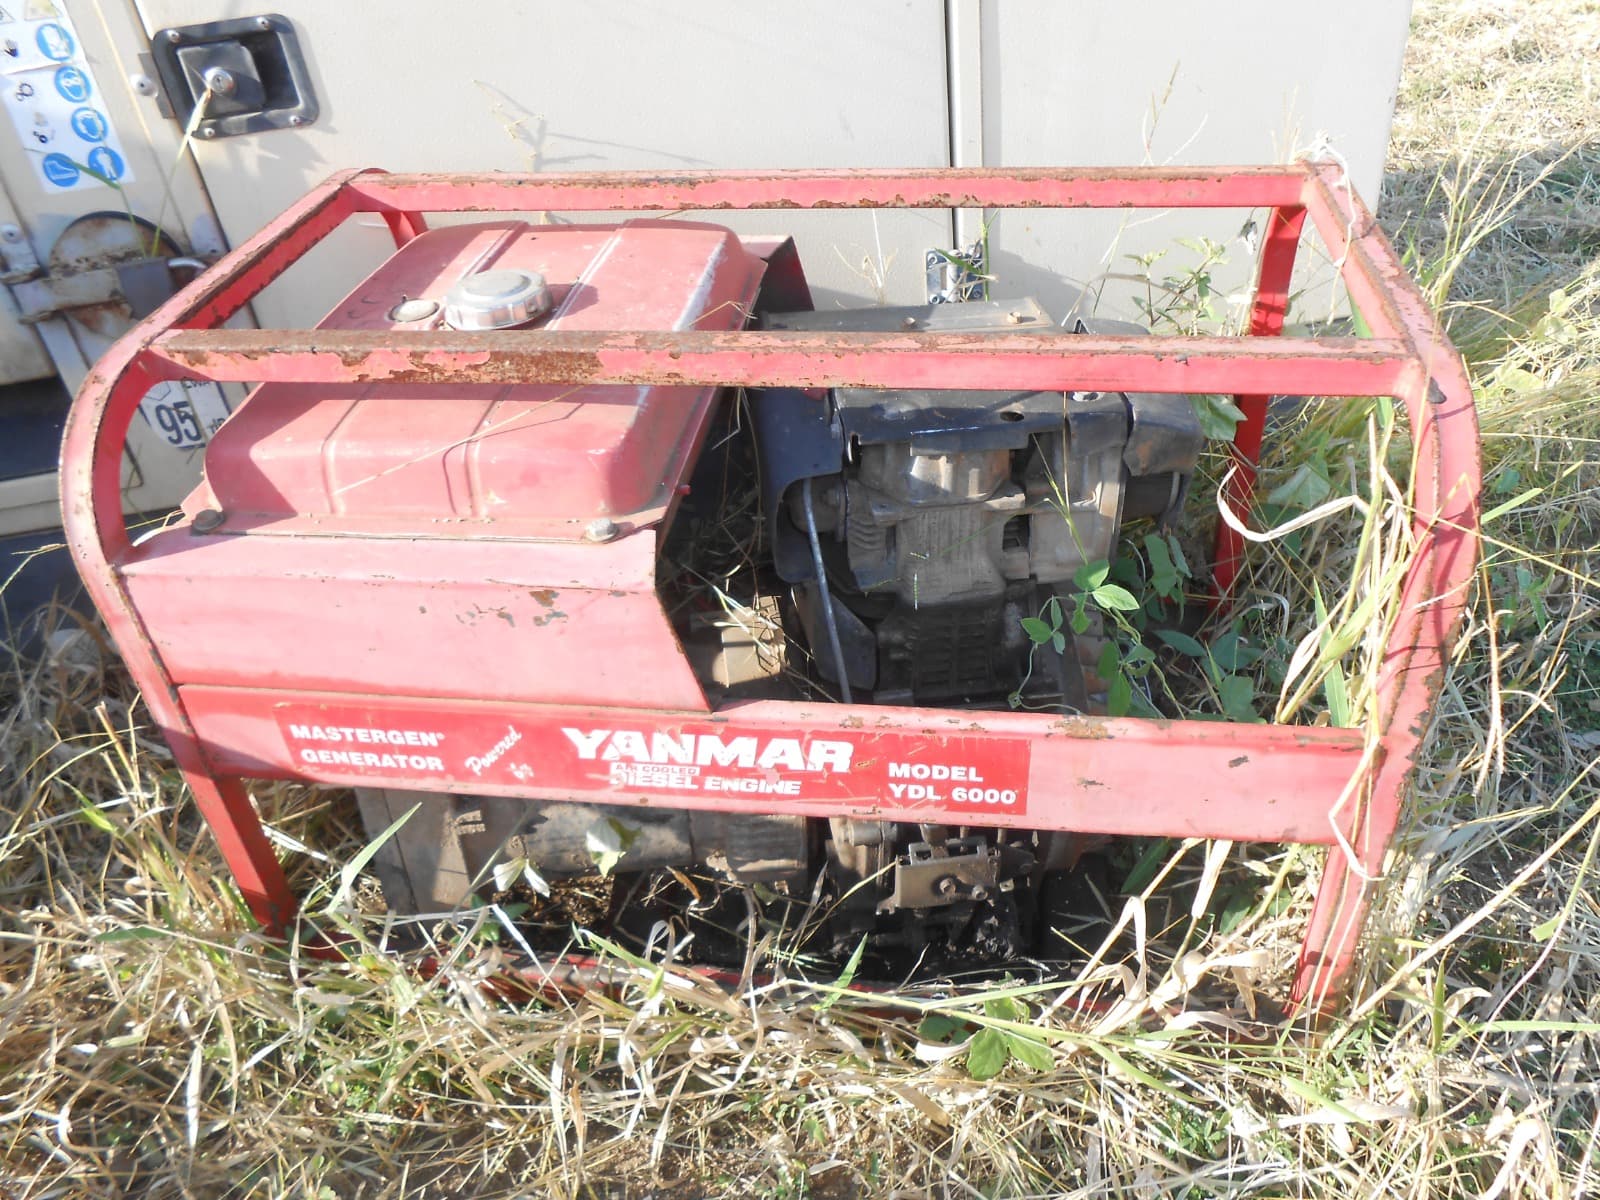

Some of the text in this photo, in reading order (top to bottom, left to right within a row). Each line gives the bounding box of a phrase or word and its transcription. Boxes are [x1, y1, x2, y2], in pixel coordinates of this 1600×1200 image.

[155, 401, 202, 444] 95
[300, 748, 445, 771] GENERATOR
[561, 726, 855, 774] YANMAR
[641, 765, 698, 775] COOLED
[888, 762, 984, 782] MODEL
[609, 772, 802, 796] DIESEL ENGINE
[888, 783, 1017, 805] YDL 6000
